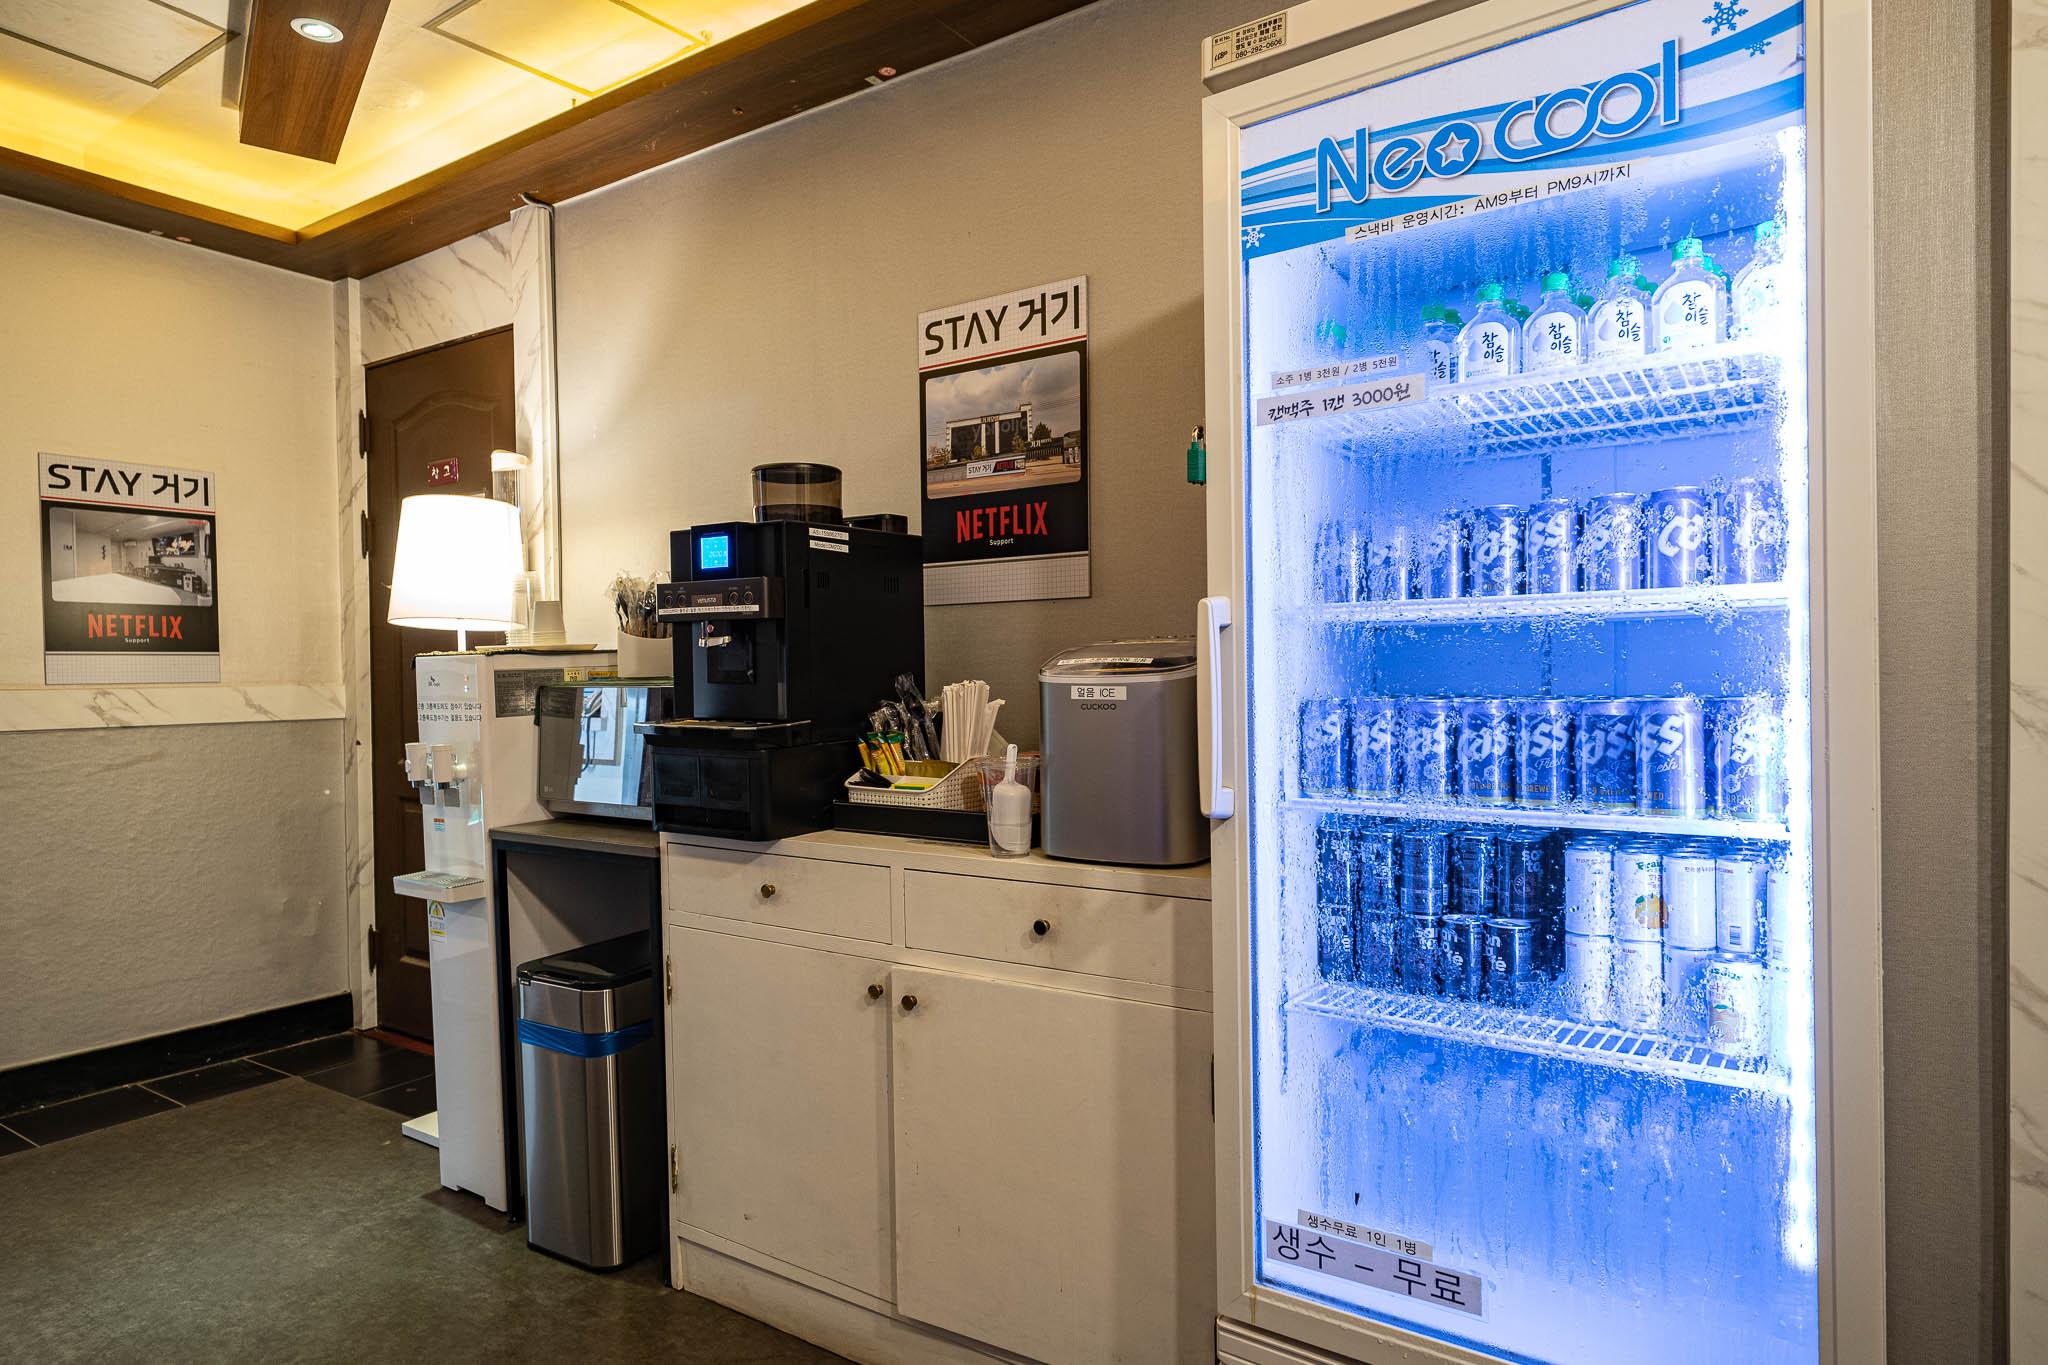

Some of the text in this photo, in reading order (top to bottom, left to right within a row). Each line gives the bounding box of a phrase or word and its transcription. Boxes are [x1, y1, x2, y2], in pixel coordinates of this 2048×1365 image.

[1235, 38, 1283, 59] 080-292-0606
[1354, 163, 1630, 240] 스낵바 운영시간: AM9부터 PM9시까지
[924, 284, 1081, 356] STAY 거기
[1276, 373, 1295, 385] 소주
[1298, 370, 1312, 382] 1병
[1316, 366, 1340, 379] 3천원
[1353, 361, 1367, 373] 2병
[1372, 356, 1397, 370] 5천원
[1267, 382, 1411, 422] 캔맥주 1캔 3000원
[48, 463, 210, 507] STAY 거기
[955, 501, 1048, 544] NETFLIX
[989, 537, 1014, 546] Support
[87, 613, 184, 640] NETFLIX
[124, 636, 150, 644] Support
[1077, 687, 1116, 698] 얼음 ICE
[1080, 703, 1117, 711] CUCKOO
[1307, 1214, 1417, 1256] 생수무료 1인 1병
[1272, 1224, 1336, 1270] 생수
[1392, 1257, 1466, 1306] 무료
